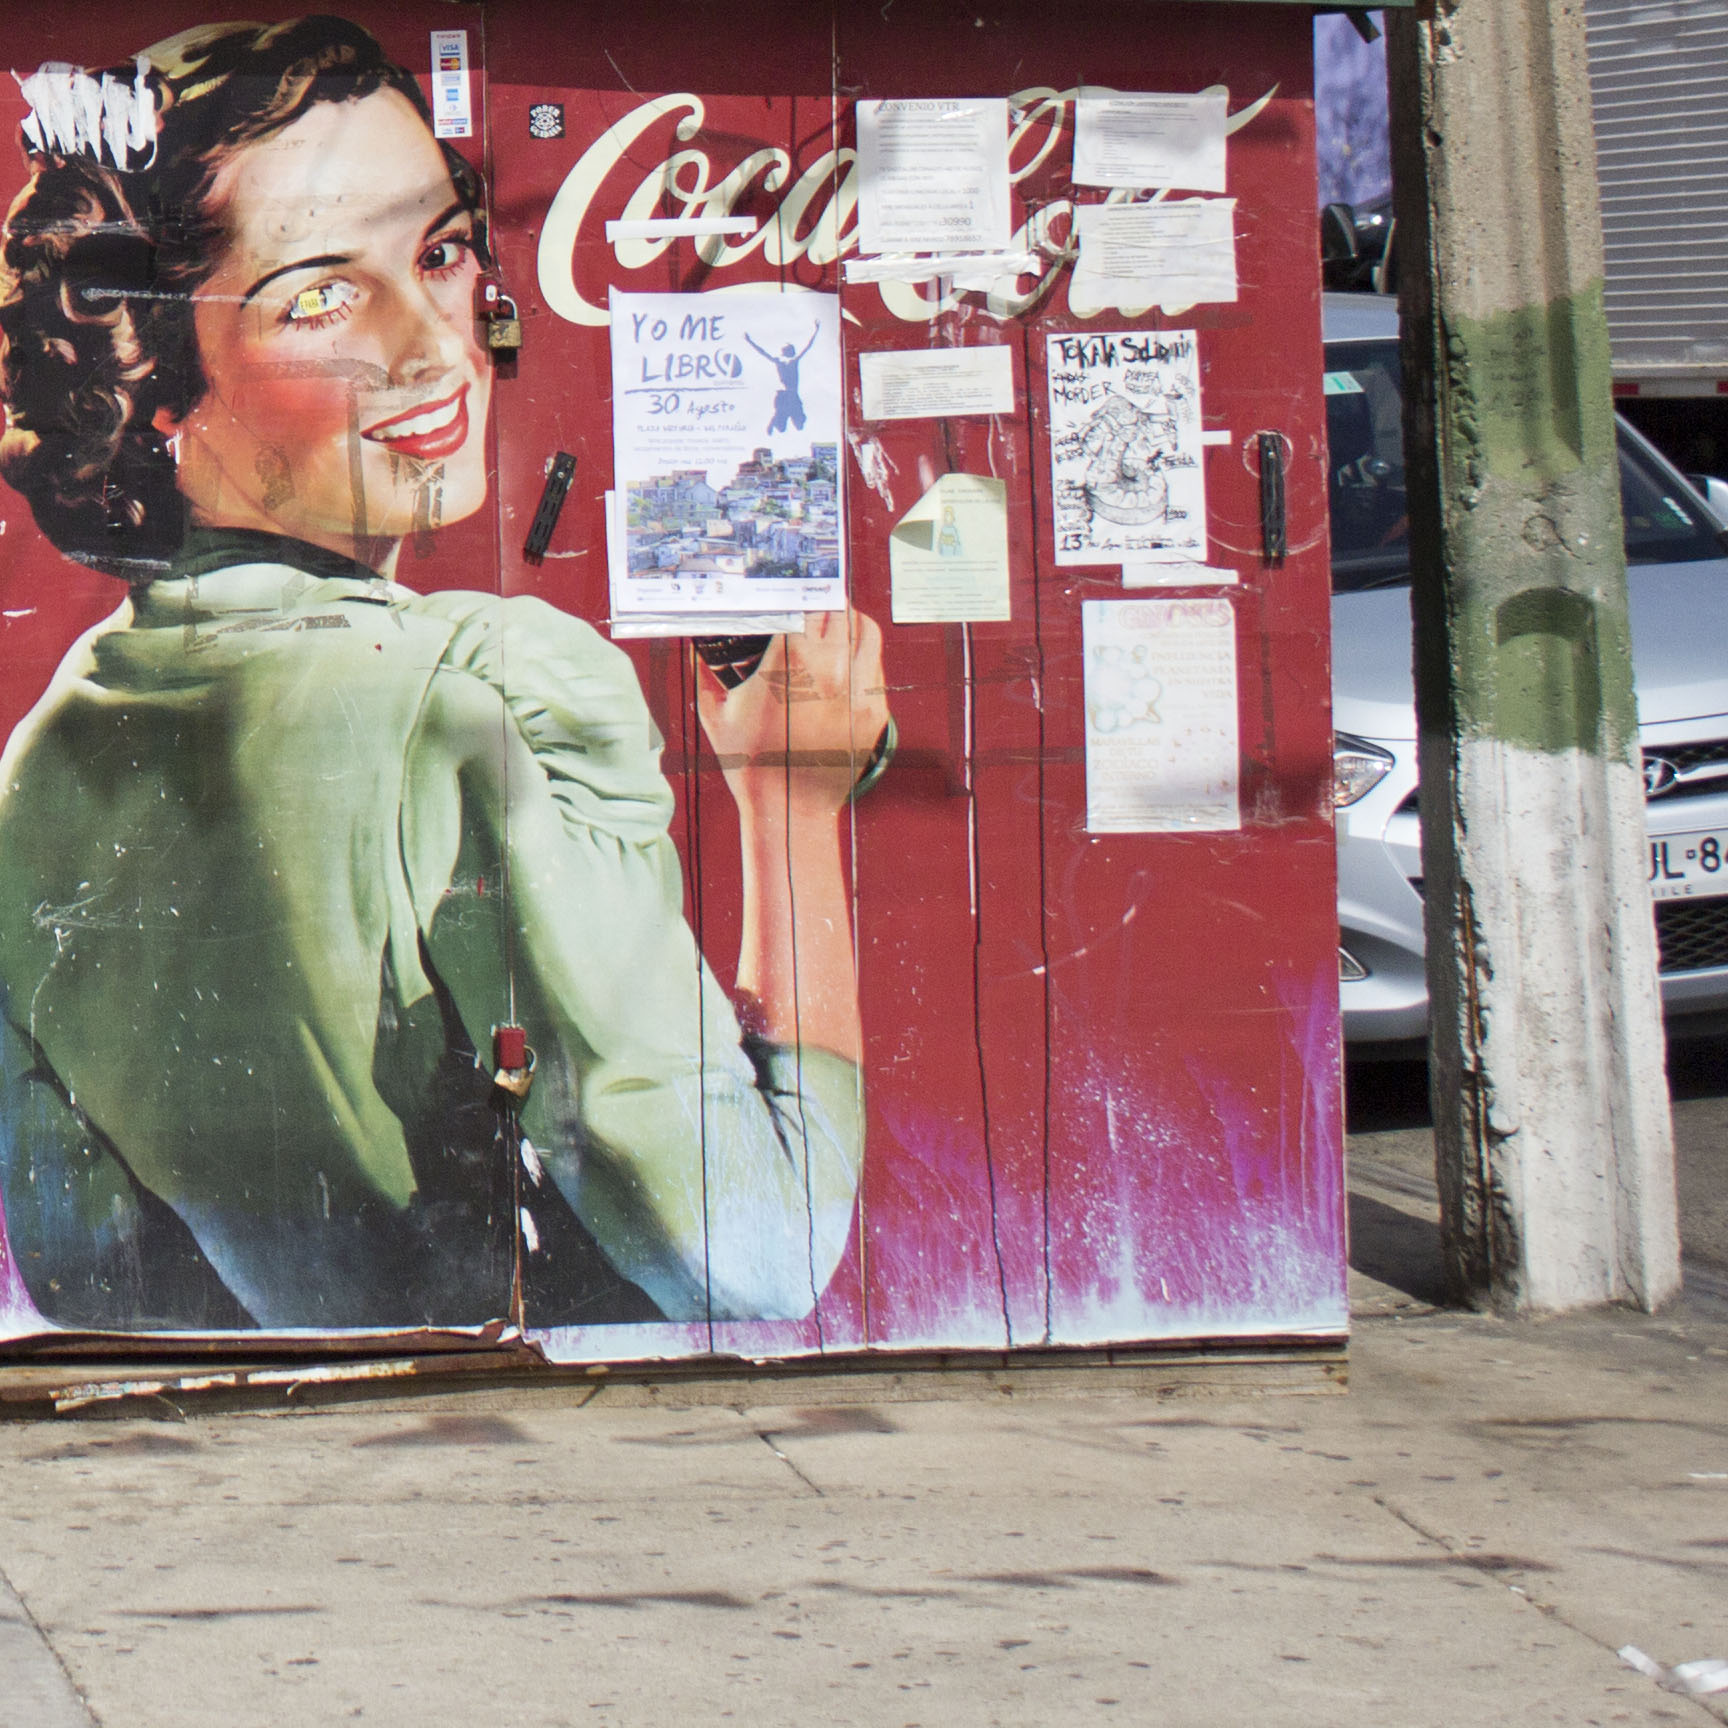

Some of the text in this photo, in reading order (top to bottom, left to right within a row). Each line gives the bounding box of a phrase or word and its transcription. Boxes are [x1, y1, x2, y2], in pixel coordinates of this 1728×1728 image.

[878, 101, 935, 112] CONVENIO
[632, 312, 725, 344] YO ME
[647, 392, 736, 421] 30 Agosto
